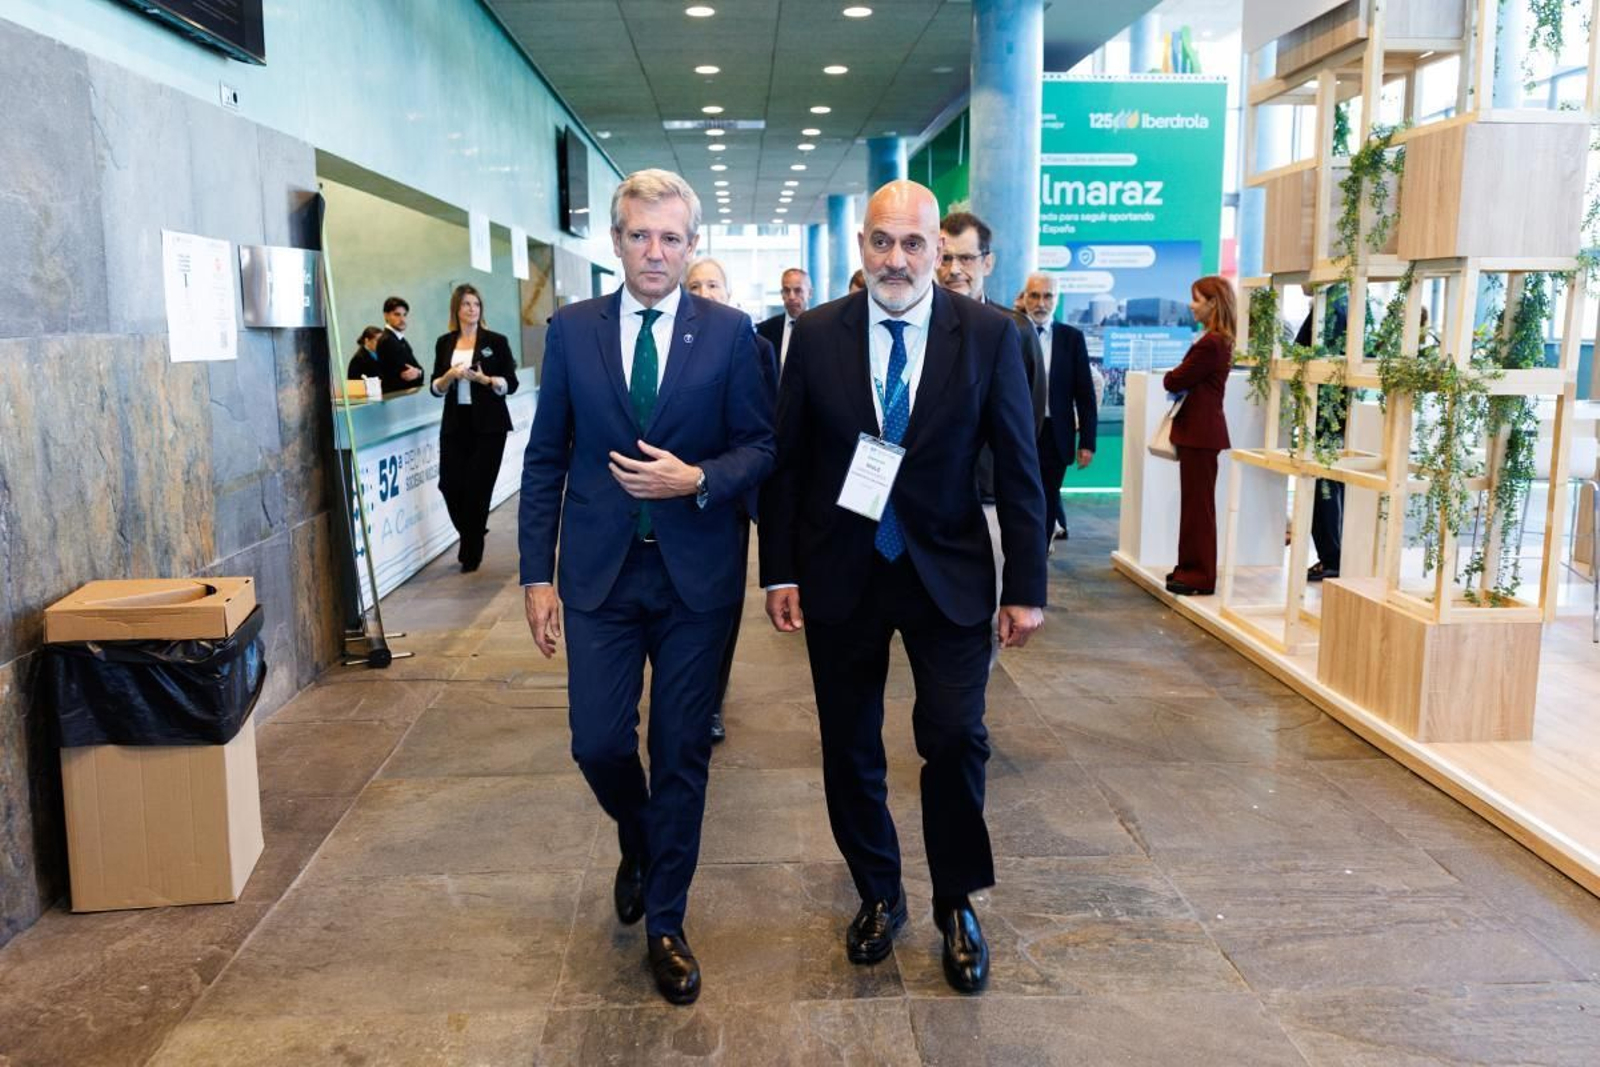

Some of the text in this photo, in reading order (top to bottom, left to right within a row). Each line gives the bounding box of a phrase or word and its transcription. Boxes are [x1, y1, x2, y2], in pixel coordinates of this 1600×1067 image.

[1089, 113, 1210, 129] 125 Iberdrola
[1040, 173, 1164, 206] lmaraz
[1059, 213, 1079, 223] para
[1080, 211, 1107, 223] seguir
[1108, 211, 1155, 223] aportando
[1042, 223, 1076, 235] España
